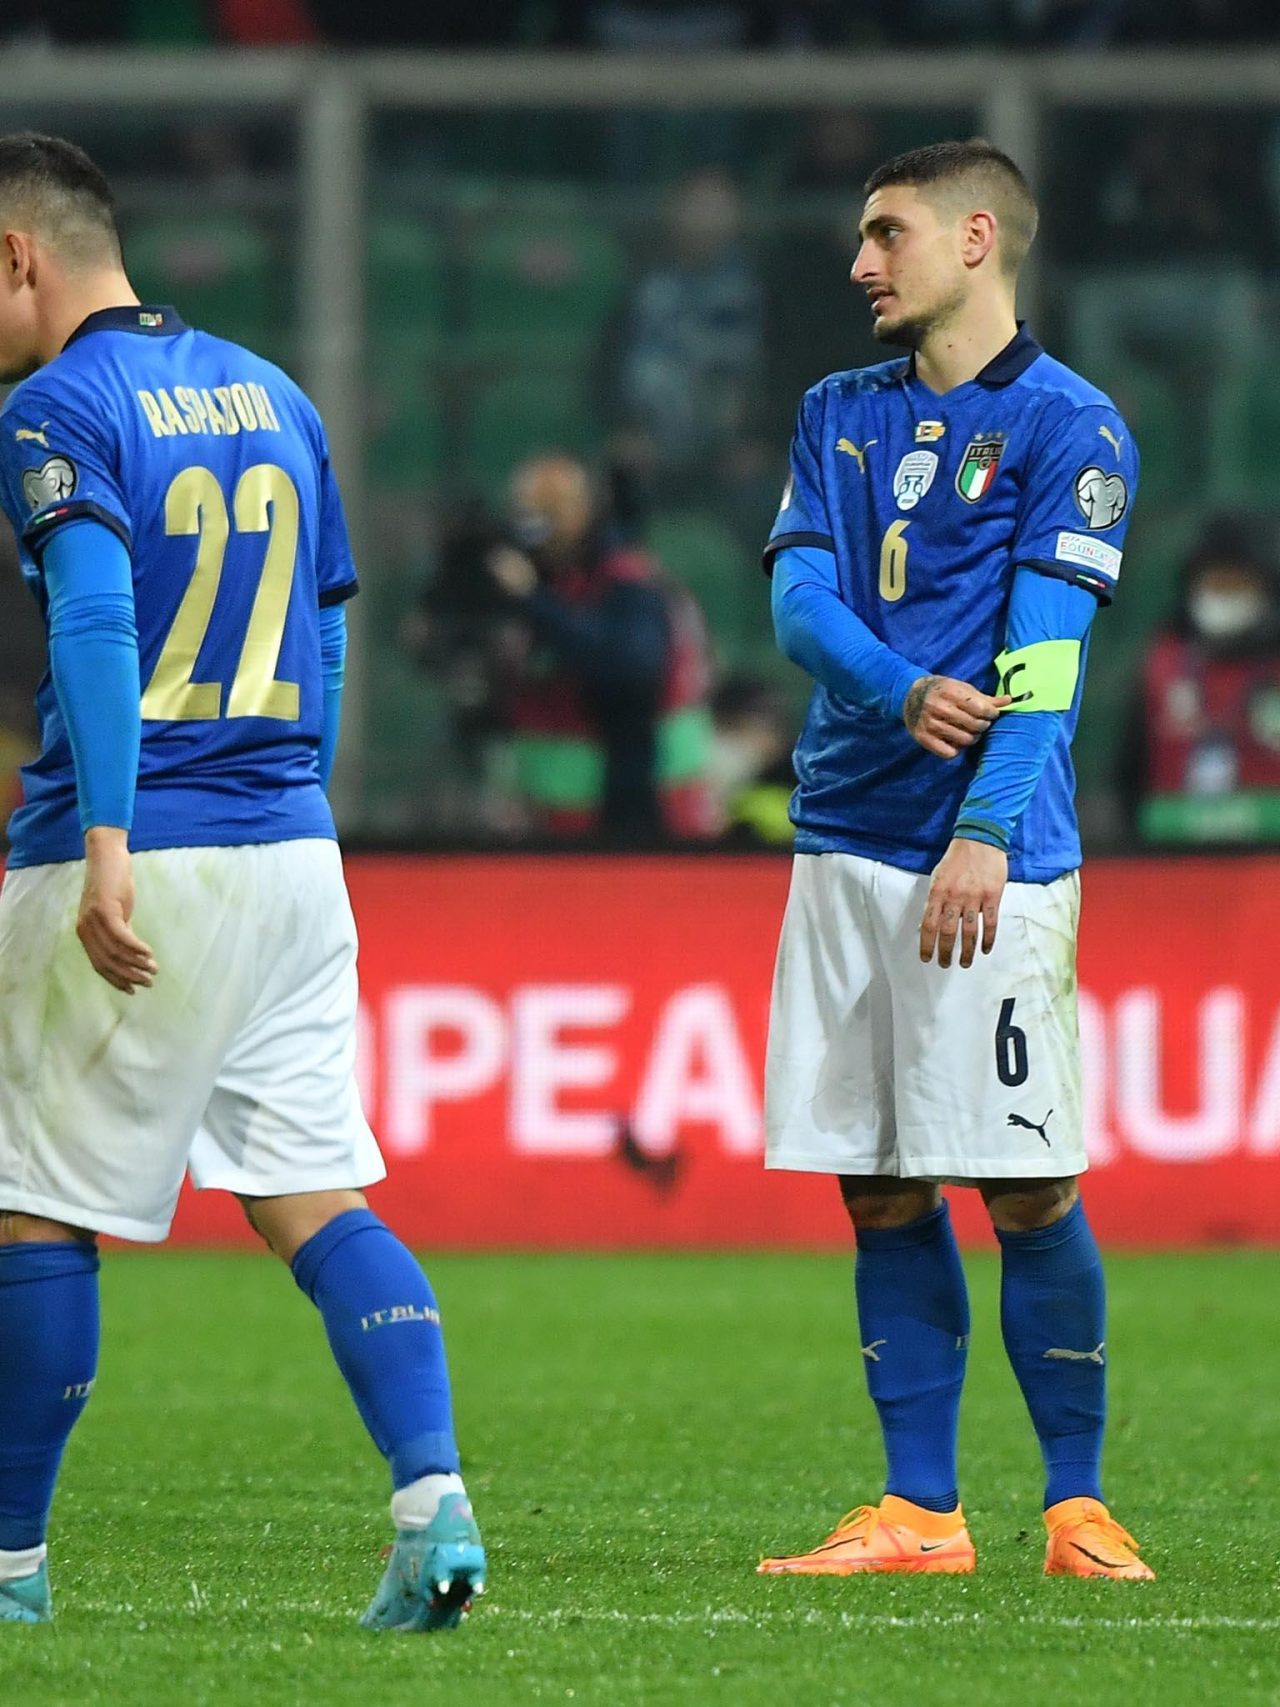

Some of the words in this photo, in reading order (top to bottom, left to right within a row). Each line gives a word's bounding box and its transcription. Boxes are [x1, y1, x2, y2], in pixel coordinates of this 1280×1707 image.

[140, 463, 300, 721] 22
[878, 518, 912, 602] 6
[1002, 662, 1034, 704] C
[994, 996, 1030, 1088] 6
